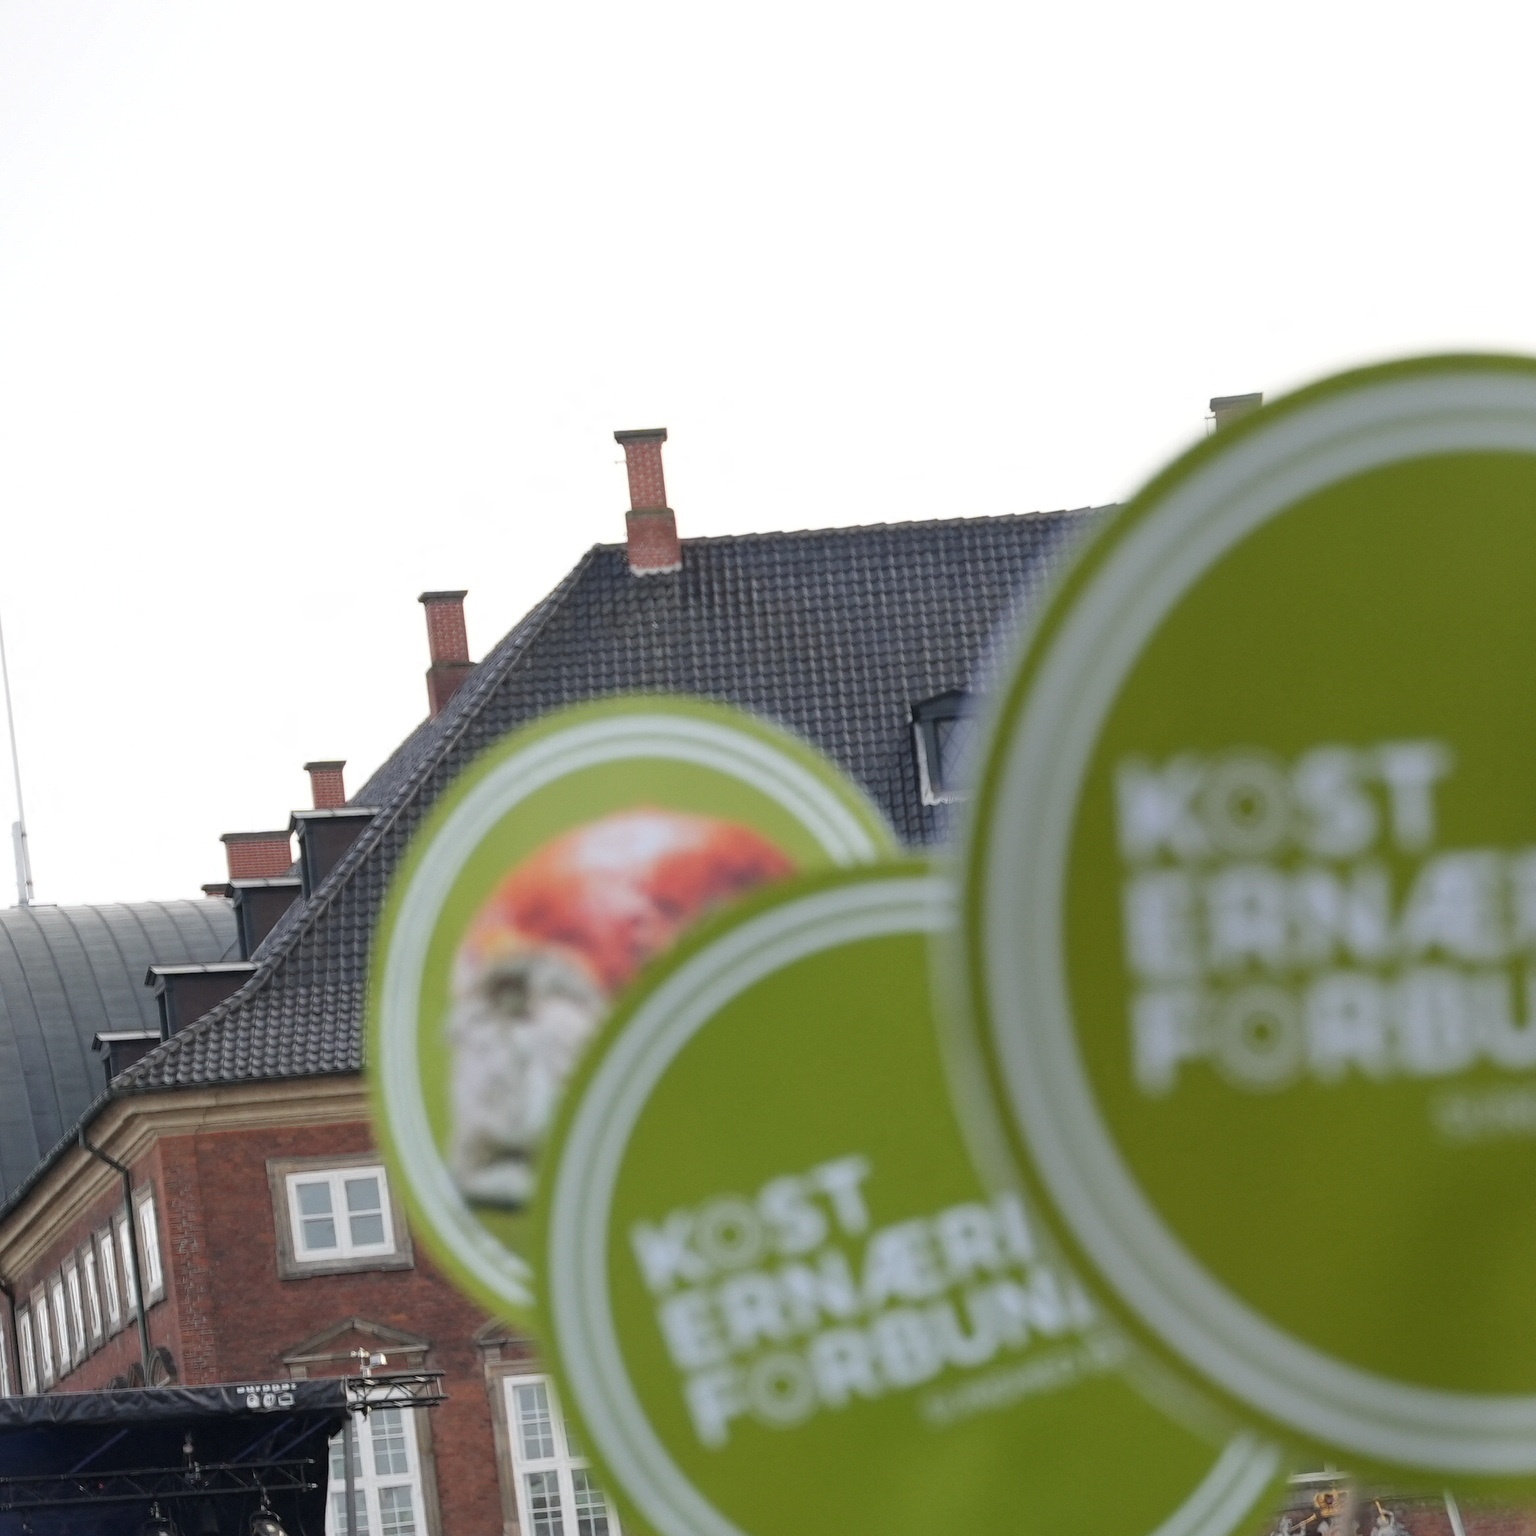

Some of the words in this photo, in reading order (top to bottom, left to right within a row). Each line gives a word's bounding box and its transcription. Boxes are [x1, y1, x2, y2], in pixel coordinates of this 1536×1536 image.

[1115, 738, 1450, 859] KOST
[629, 1155, 871, 1292] KOST
[657, 1190, 1035, 1373] ERNÆRI
[684, 1265, 1096, 1450] FORBUN
